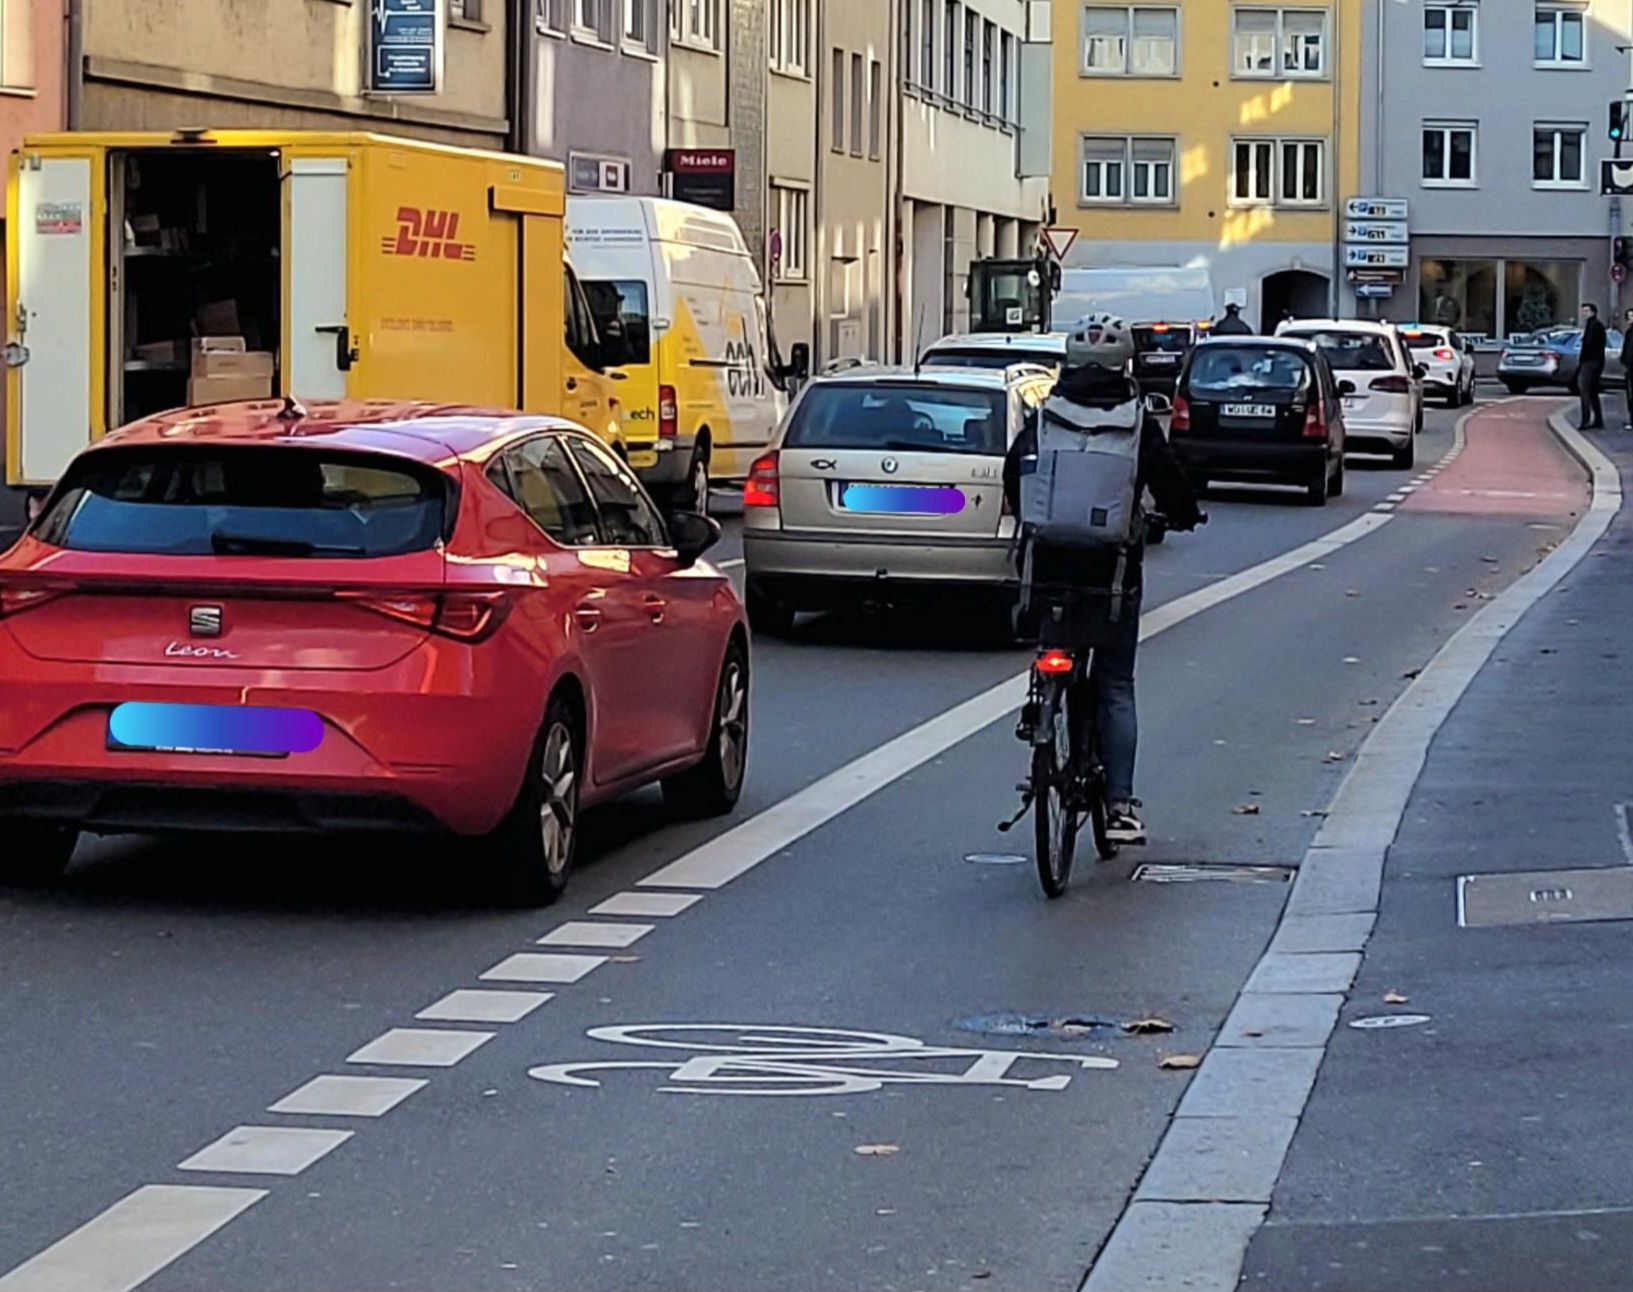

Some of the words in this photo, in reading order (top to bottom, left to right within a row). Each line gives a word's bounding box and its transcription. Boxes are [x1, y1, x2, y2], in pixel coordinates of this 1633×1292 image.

[680, 154, 728, 167] Miele
[394, 206, 464, 261] DHL
[630, 406, 655, 421] ech
[164, 640, 241, 660] Leon
